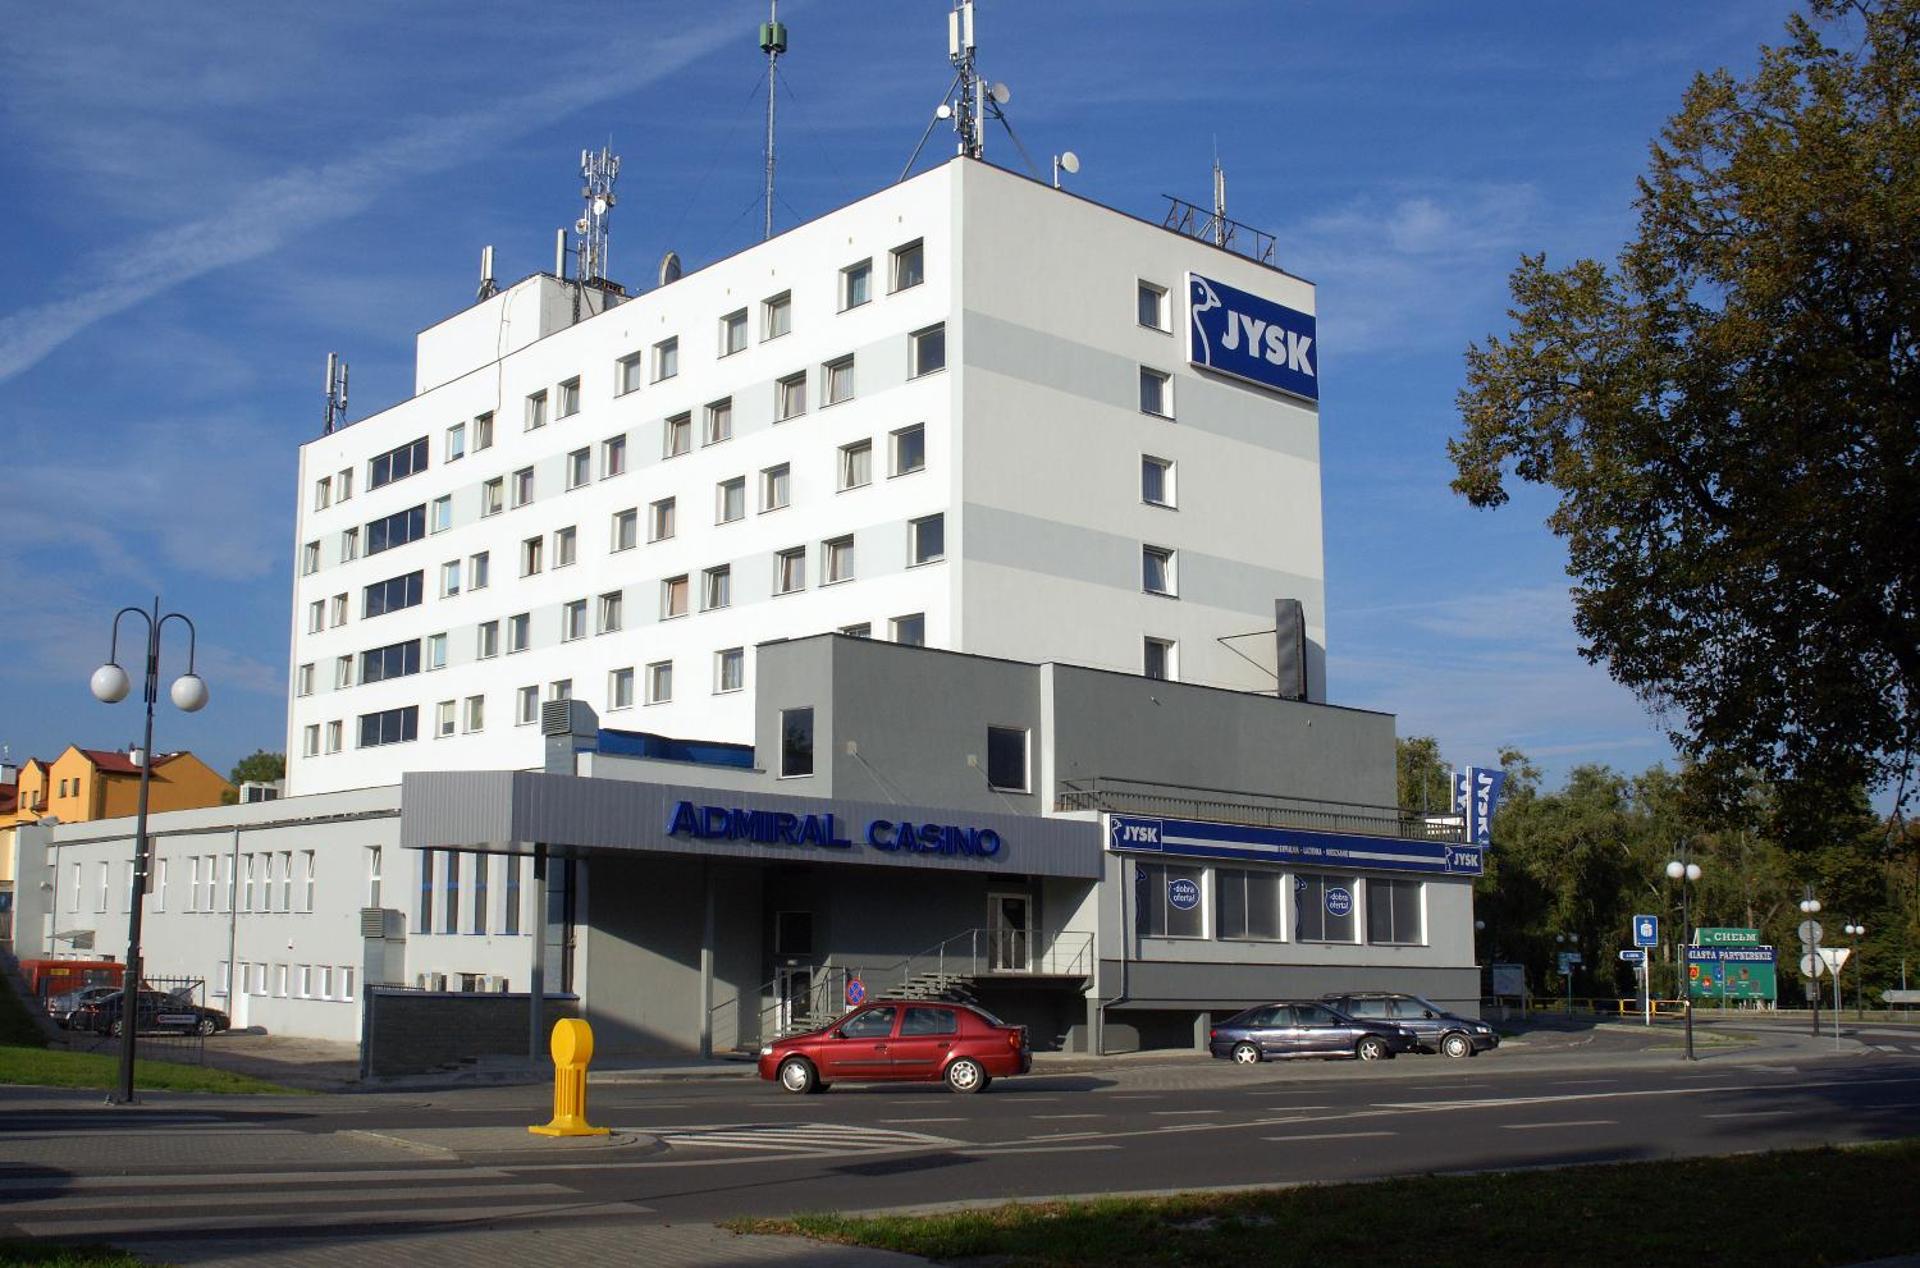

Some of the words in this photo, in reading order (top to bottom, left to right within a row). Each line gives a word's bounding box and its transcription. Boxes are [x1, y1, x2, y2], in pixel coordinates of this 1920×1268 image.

[1221, 310, 1315, 377] JYSK
[666, 800, 852, 849] ADMIRAL
[864, 819, 1002, 858] CASINO
[1477, 772, 1493, 836] JYSK
[1122, 825, 1159, 843] JYSK
[1453, 852, 1479, 867] JYSK
